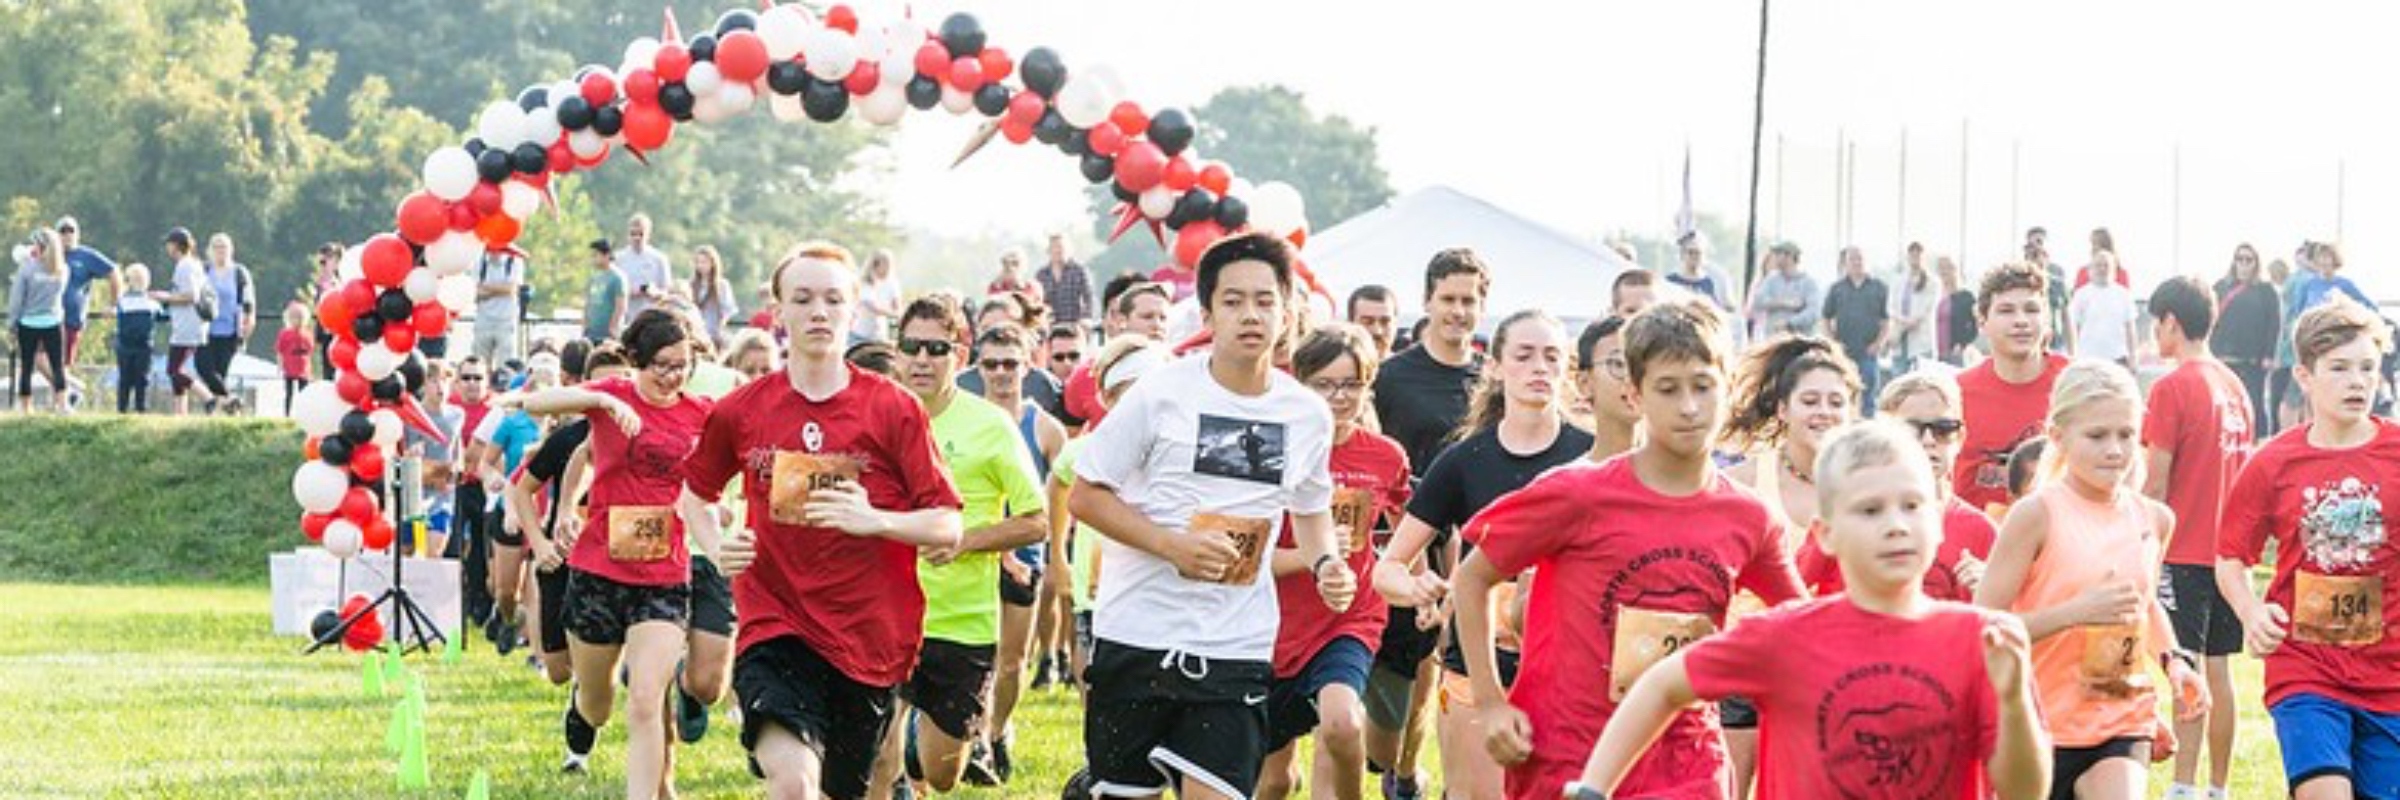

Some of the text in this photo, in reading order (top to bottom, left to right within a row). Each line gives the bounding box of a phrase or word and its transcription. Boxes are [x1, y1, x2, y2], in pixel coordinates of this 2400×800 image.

[633, 517, 666, 540] 258
[1627, 547, 1683, 572] CROSS
[2330, 593, 2370, 618] 134
